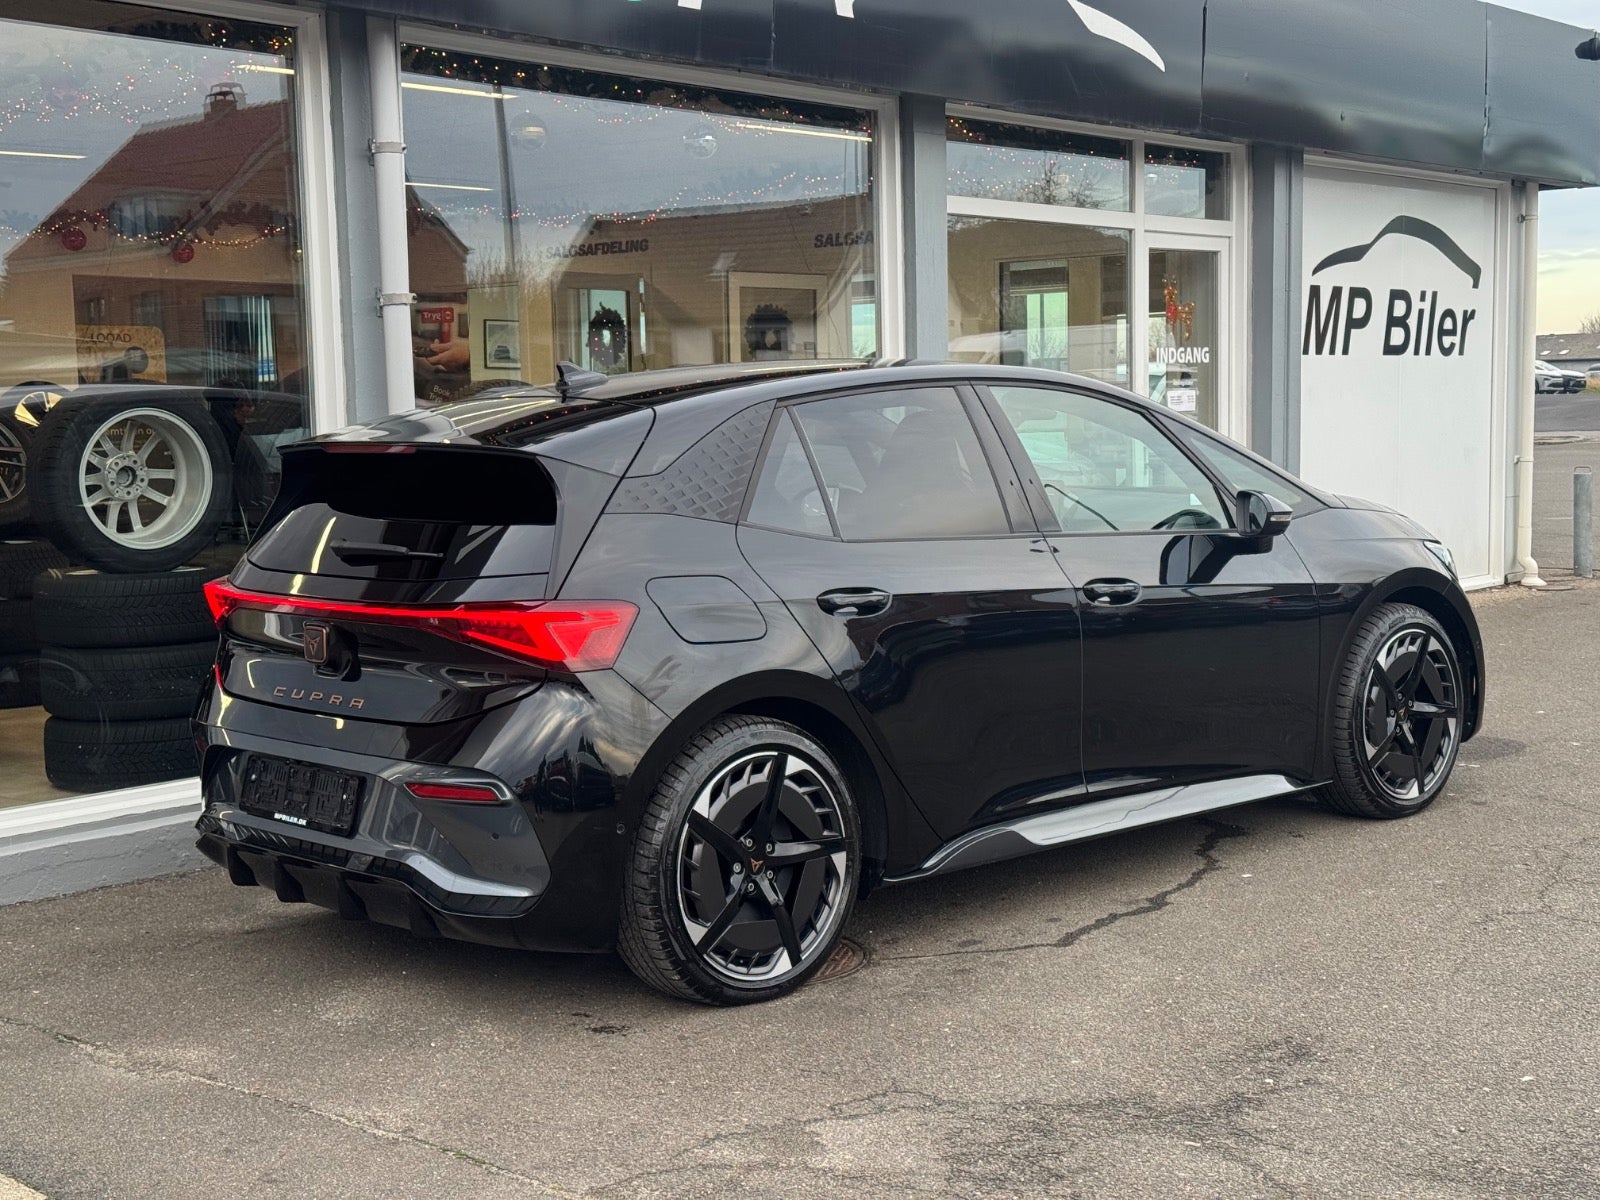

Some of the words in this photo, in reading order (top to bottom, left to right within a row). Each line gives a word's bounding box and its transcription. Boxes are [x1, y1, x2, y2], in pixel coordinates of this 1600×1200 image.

[546, 239, 649, 258] SALGSAFDELING
[1302, 285, 1372, 356] MP
[1382, 289, 1476, 357] Biler
[1156, 347, 1210, 363] INDGANG
[273, 686, 365, 709] CUPRA
